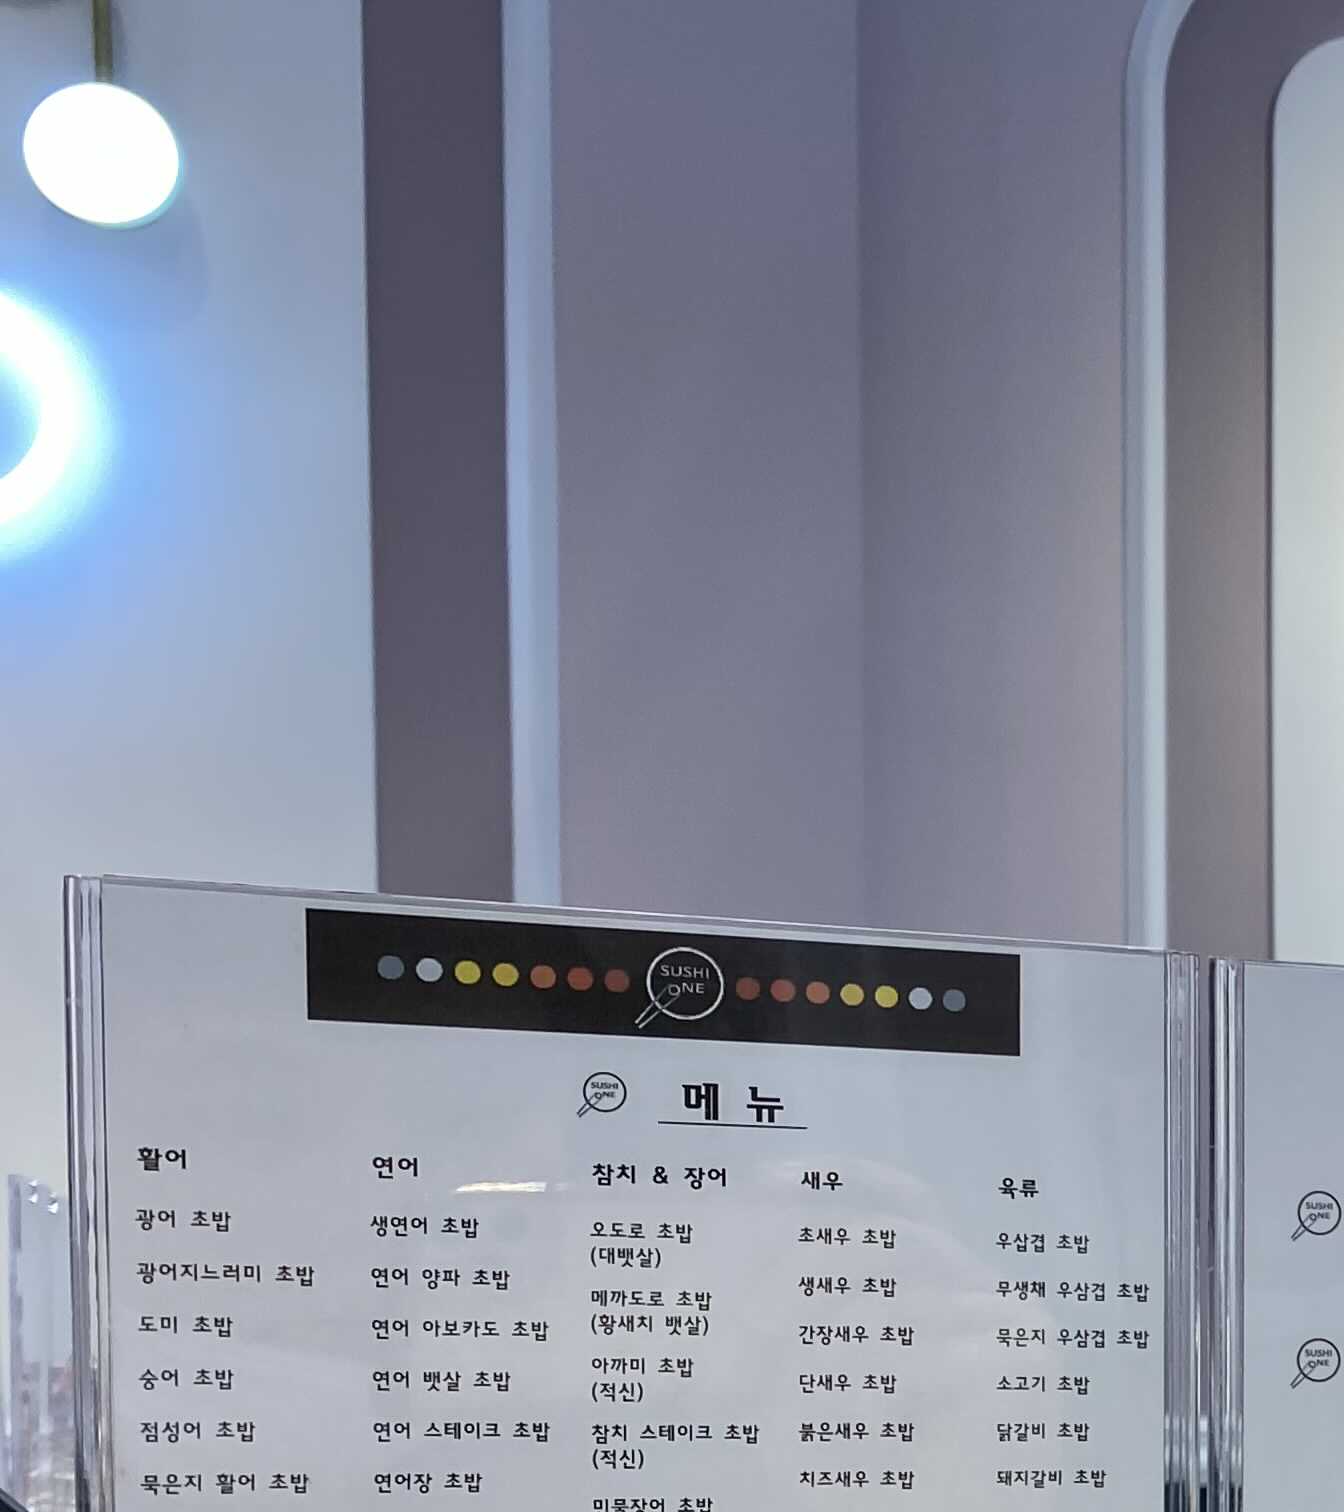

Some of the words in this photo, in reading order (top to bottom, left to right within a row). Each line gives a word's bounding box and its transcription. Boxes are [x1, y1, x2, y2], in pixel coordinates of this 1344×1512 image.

[660, 964, 710, 980] SUSHI
[668, 981, 705, 998] ONE
[137, 1146, 187, 1172] 활어
[372, 1156, 418, 1180] 연어
[591, 1162, 636, 1187] 참치
[652, 1165, 669, 1185] &
[683, 1167, 727, 1191] 장어
[800, 1171, 844, 1192] 새우
[997, 1177, 1040, 1200] 육류
[135, 1209, 176, 1232] 광어
[190, 1210, 232, 1233] 초밥
[370, 1215, 428, 1238] 생연어
[440, 1216, 480, 1239] 초밥
[589, 1221, 646, 1239] 오도로
[656, 1222, 694, 1245] 초밥
[797, 1226, 851, 1246] 초새우
[136, 1262, 261, 1285] 광어지느러미
[275, 1264, 315, 1287] 초밥
[372, 1370, 410, 1392] 연어
[423, 1370, 462, 1392] 뱃살
[473, 1370, 511, 1392] 초밥
[140, 1473, 202, 1497] 묵은지
[215, 1473, 255, 1495] 활어
[268, 1473, 310, 1494] 초밥
